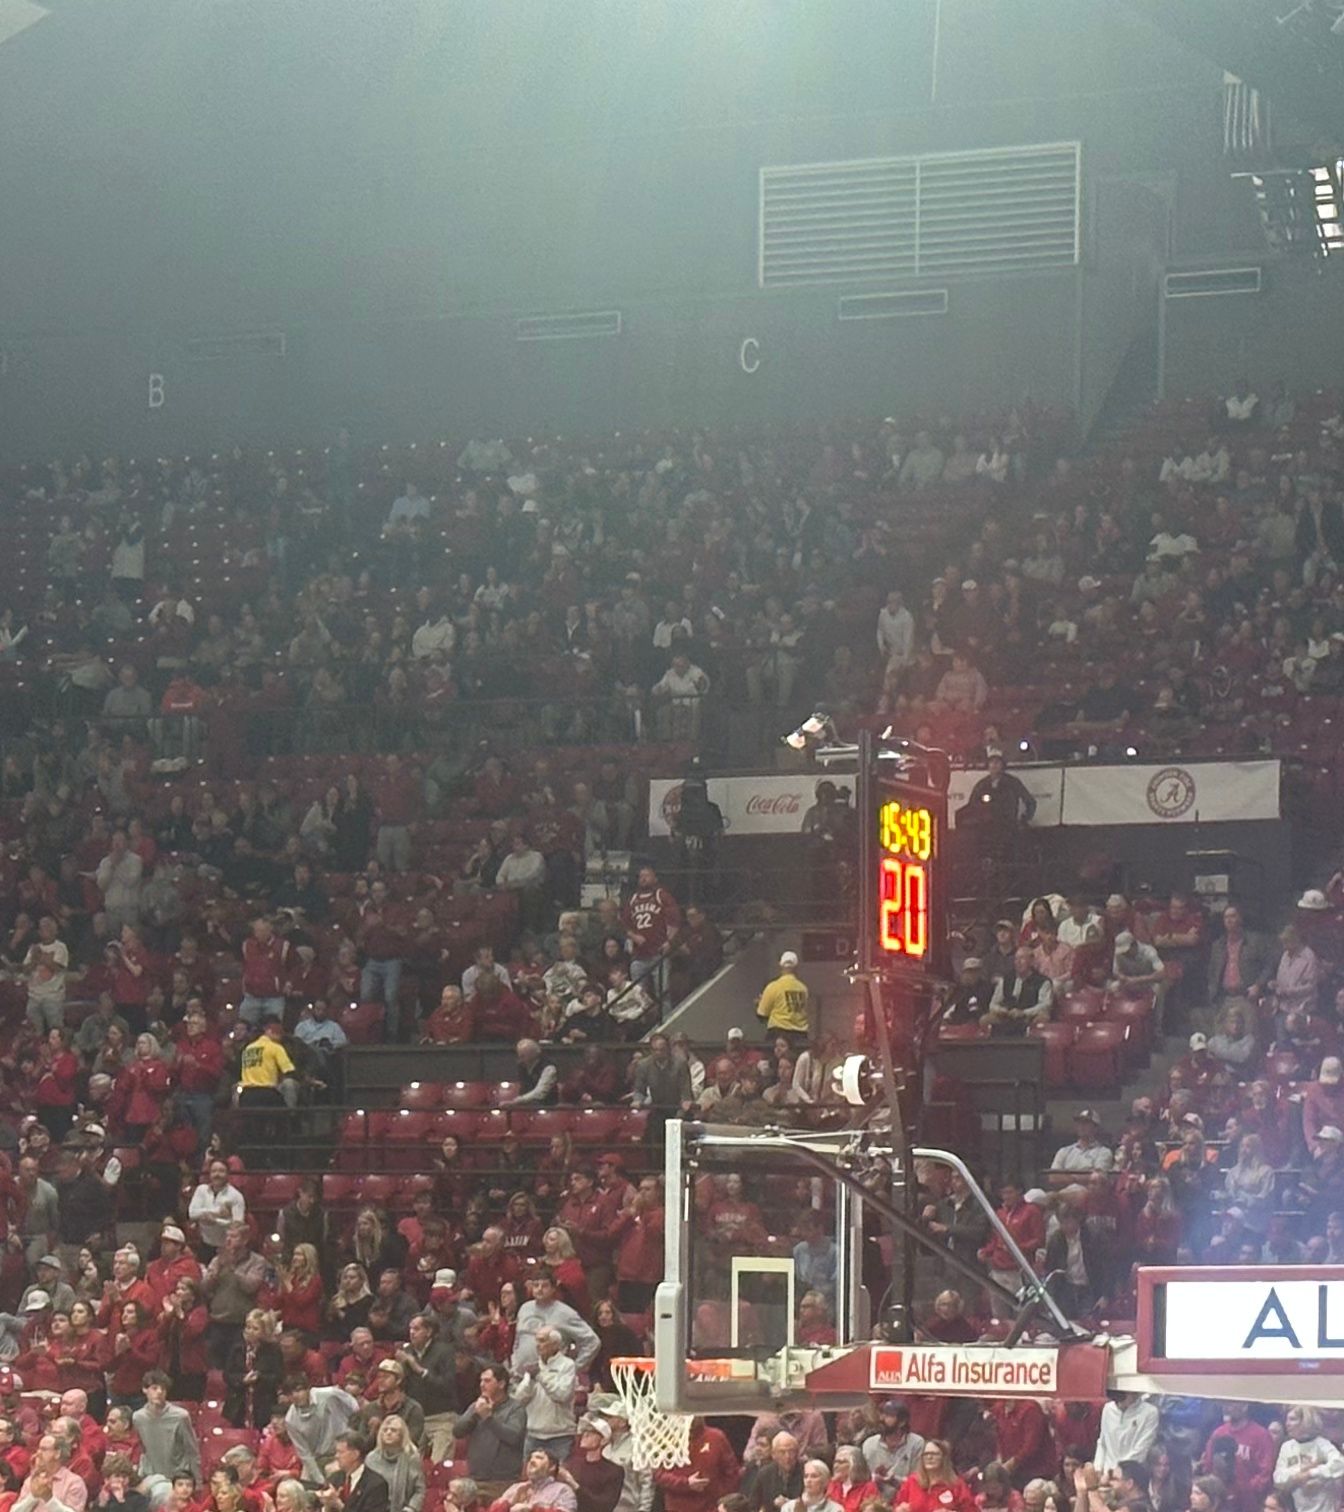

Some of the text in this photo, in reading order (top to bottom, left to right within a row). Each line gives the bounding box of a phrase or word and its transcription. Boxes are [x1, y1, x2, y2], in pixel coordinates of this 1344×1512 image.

[739, 337, 761, 374] C
[148, 372, 166, 409] B
[746, 793, 802, 815] Coca-Cola
[880, 802, 931, 861] 15:43
[636, 913, 653, 929] 22
[881, 858, 926, 956] 20
[877, 1371, 903, 1384] ALFA
[905, 1352, 1052, 1385] Alfa Insurance
